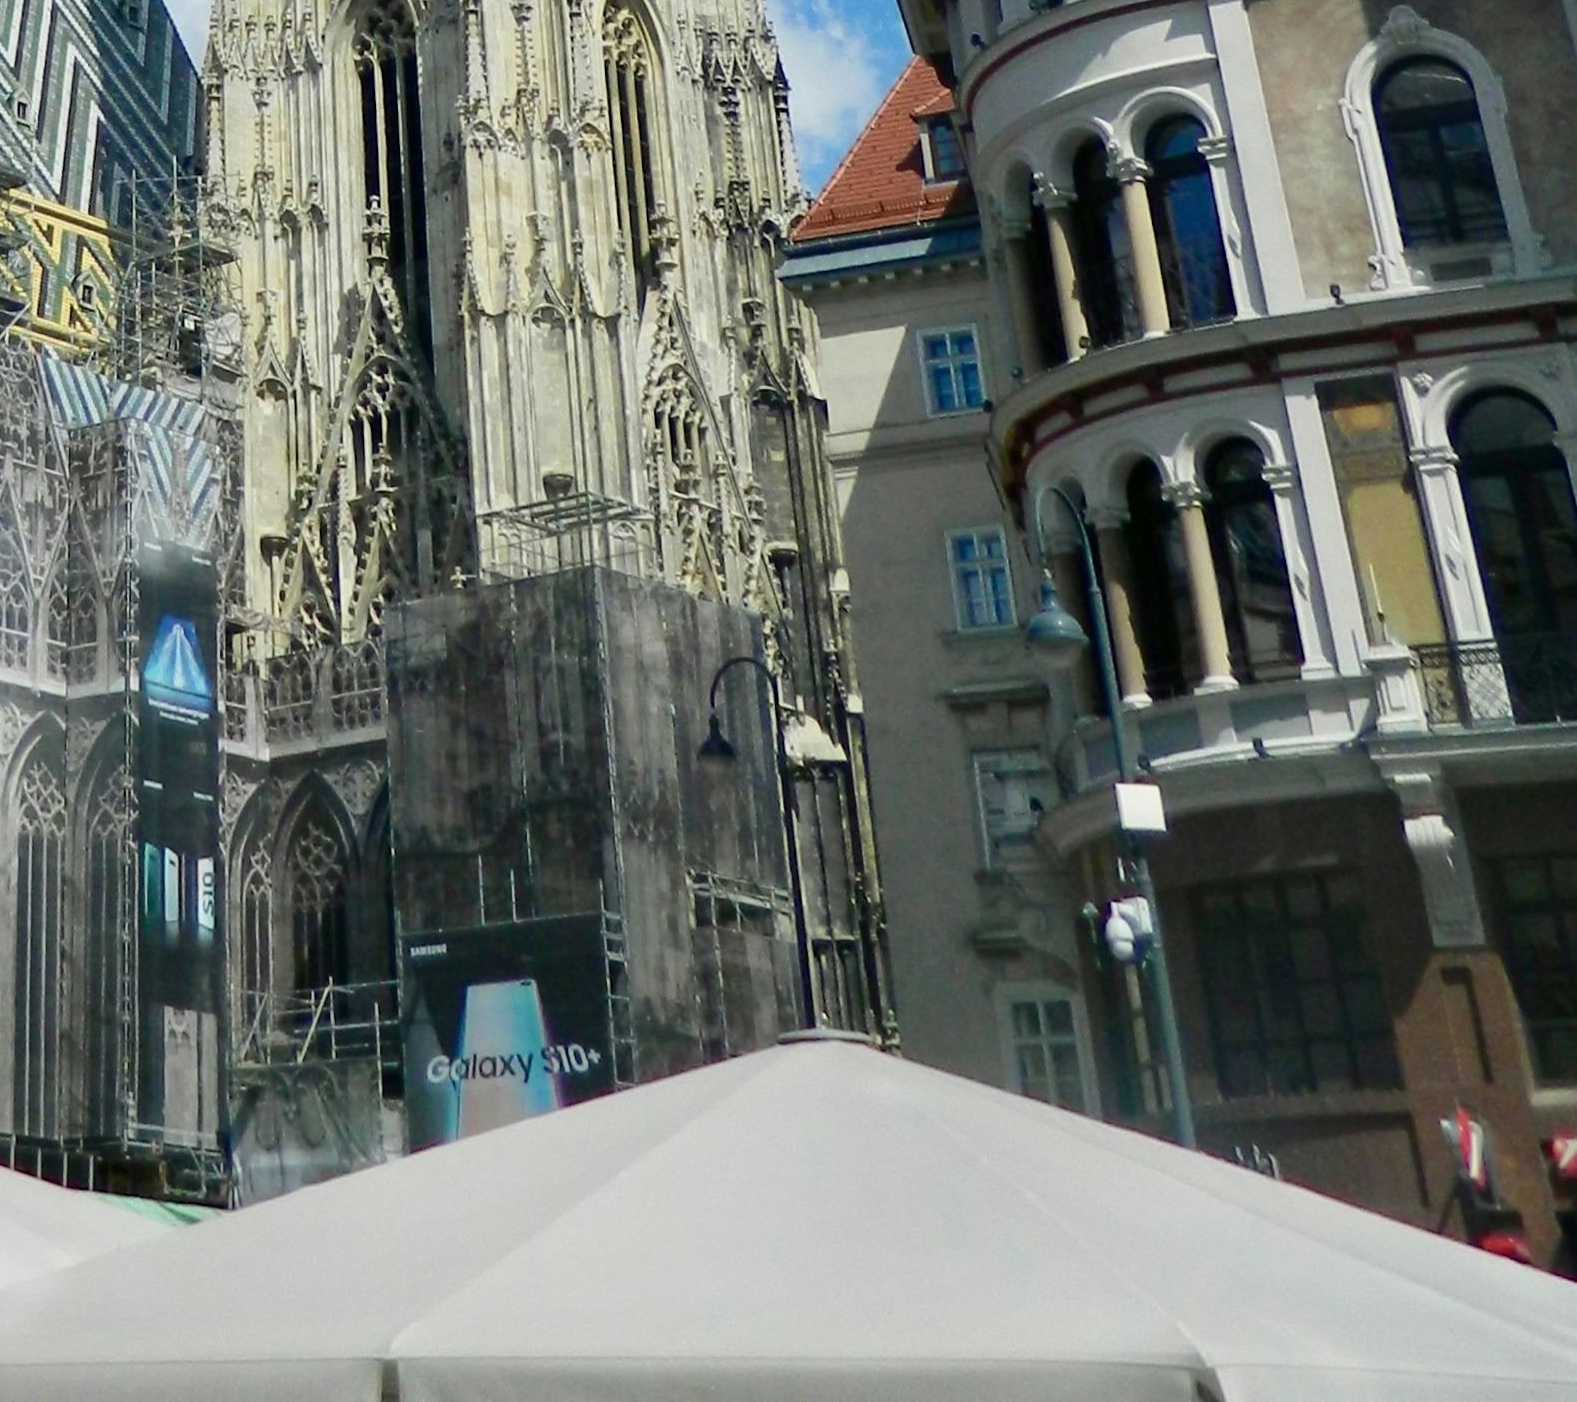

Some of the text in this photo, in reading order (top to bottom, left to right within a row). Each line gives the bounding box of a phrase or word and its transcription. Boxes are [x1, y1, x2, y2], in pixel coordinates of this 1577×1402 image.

[202, 871, 215, 916] S10
[427, 1043, 602, 1084] Galaxy S10+
